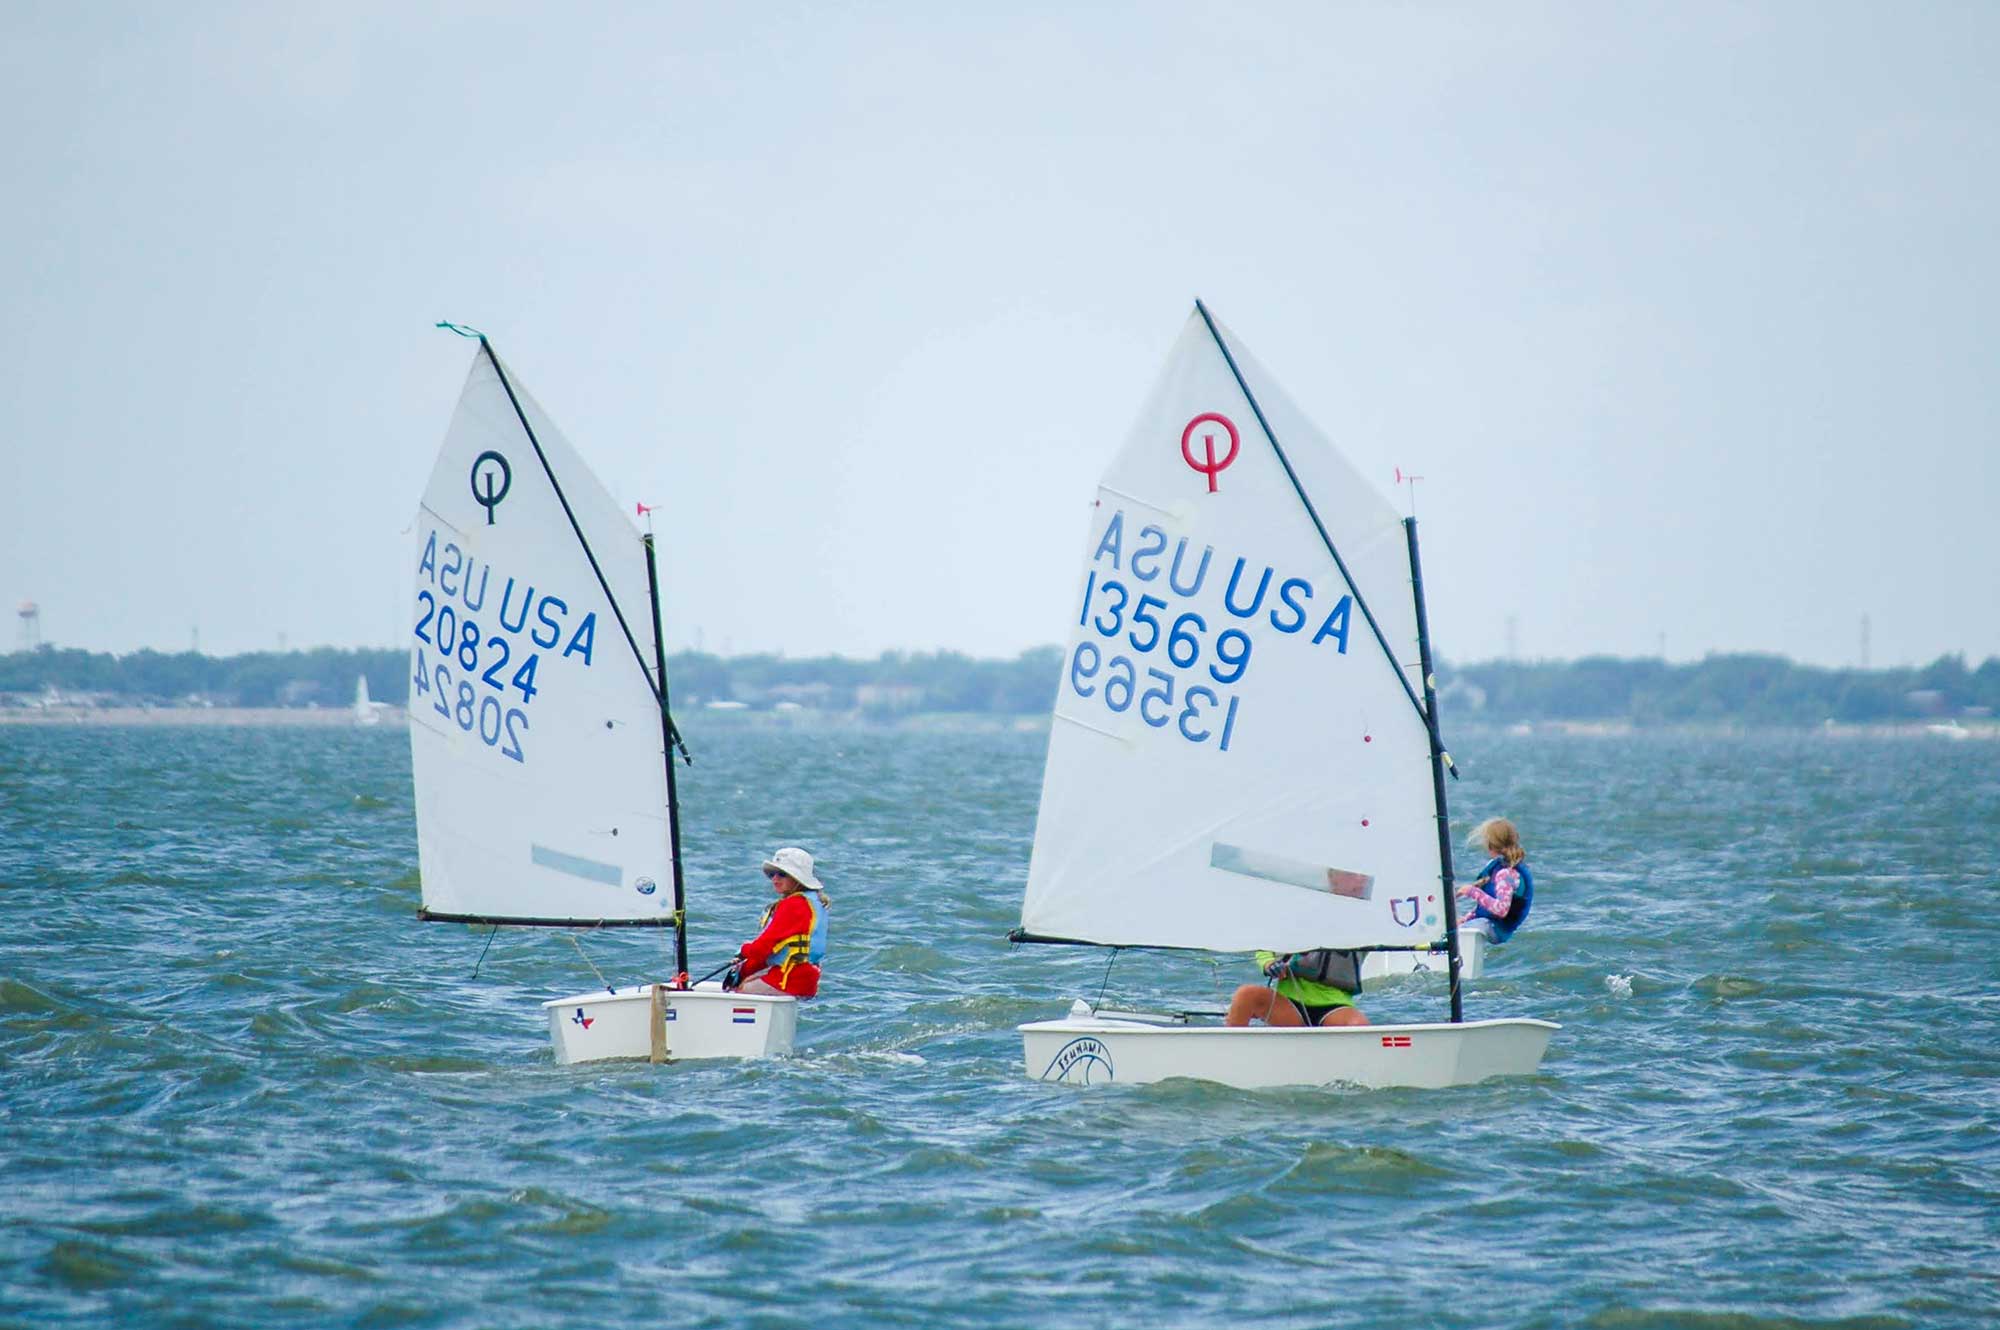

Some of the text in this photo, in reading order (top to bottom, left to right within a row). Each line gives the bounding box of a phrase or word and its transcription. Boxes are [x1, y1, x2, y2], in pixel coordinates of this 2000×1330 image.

[414, 589, 539, 704] 20824
[500, 577, 596, 667] USA
[1080, 569, 1253, 684] 13569
[1224, 556, 1354, 655] USA
